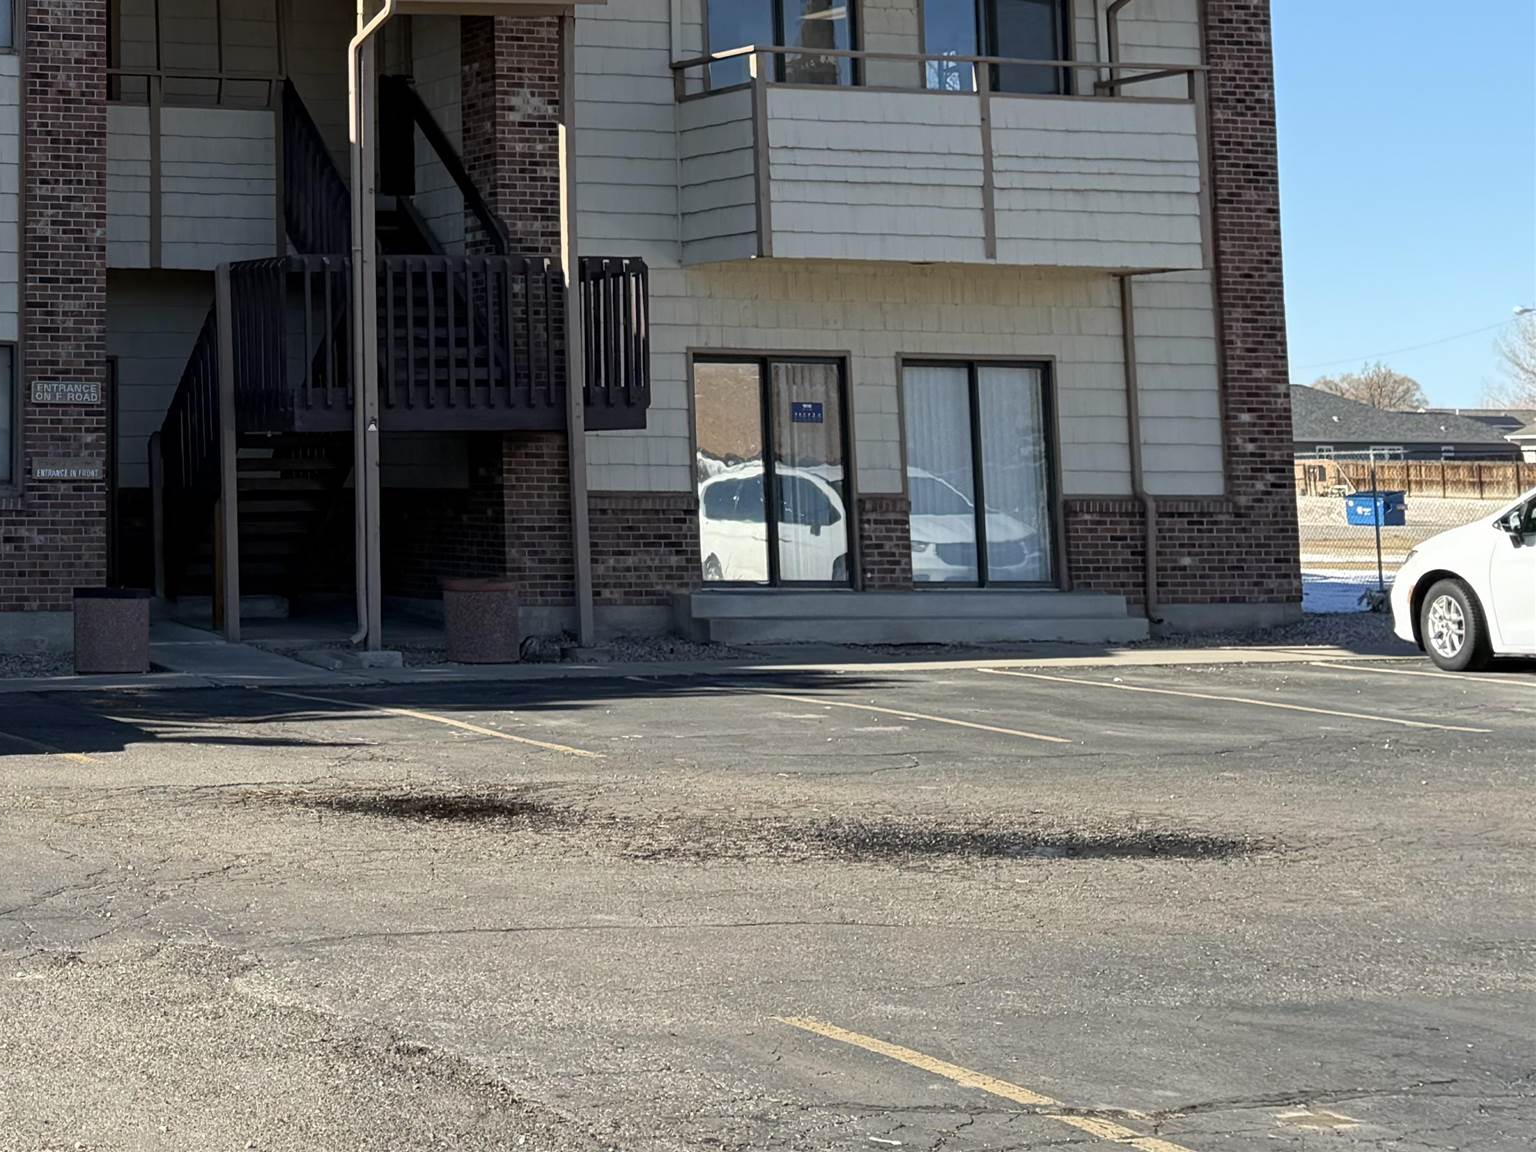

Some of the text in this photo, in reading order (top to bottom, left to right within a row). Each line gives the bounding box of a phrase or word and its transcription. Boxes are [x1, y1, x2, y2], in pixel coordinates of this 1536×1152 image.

[36, 383, 97, 393] ENTRANCE
[35, 392, 51, 401] ON
[67, 392, 98, 402] ROAD
